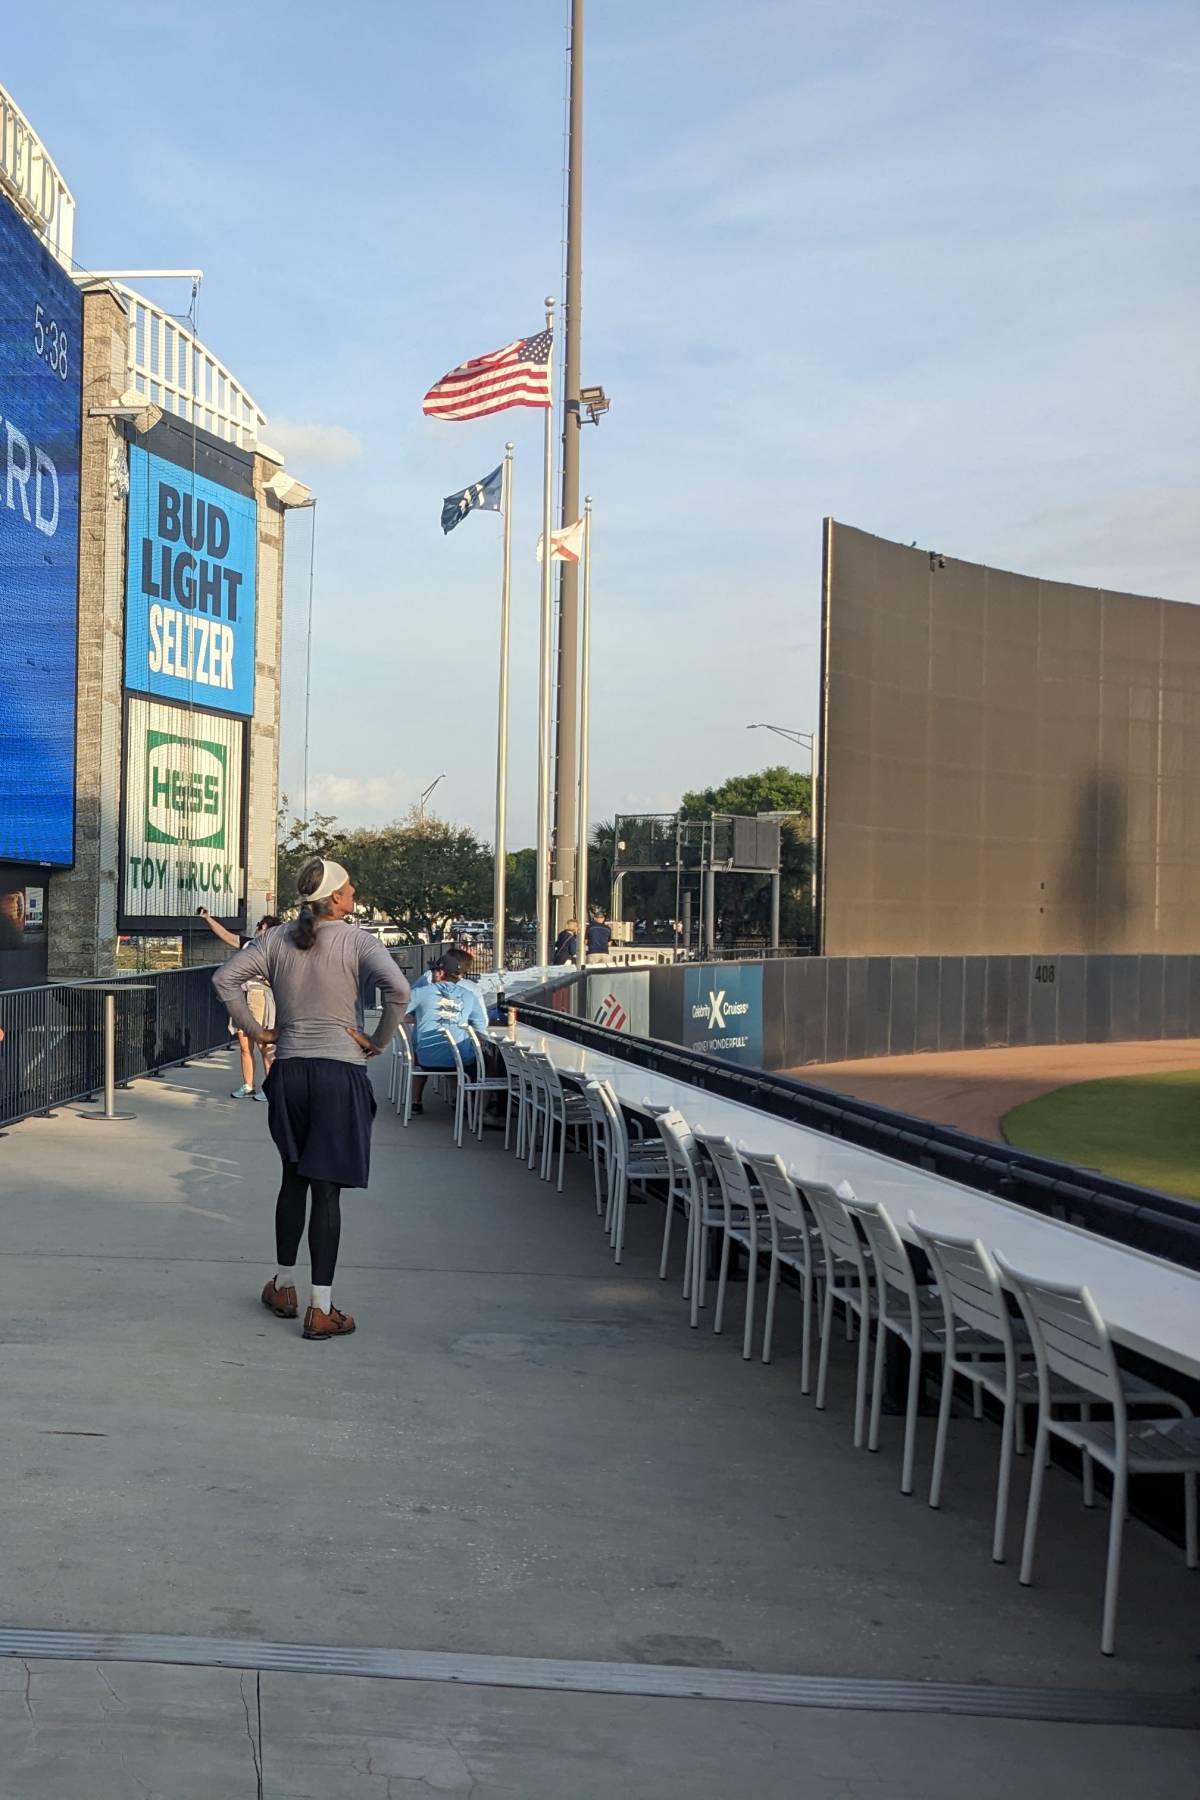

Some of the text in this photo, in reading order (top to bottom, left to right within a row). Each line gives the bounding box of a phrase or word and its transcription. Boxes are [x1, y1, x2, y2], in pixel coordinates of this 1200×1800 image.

[34, 302, 68, 381] 5:38
[158, 480, 230, 559] BUD
[142, 538, 242, 622] LIGHT
[149, 604, 234, 690] SELTZER
[130, 857, 233, 893] TOY TRUCK
[708, 991, 726, 1029] X
[1034, 965, 1055, 983] 408
